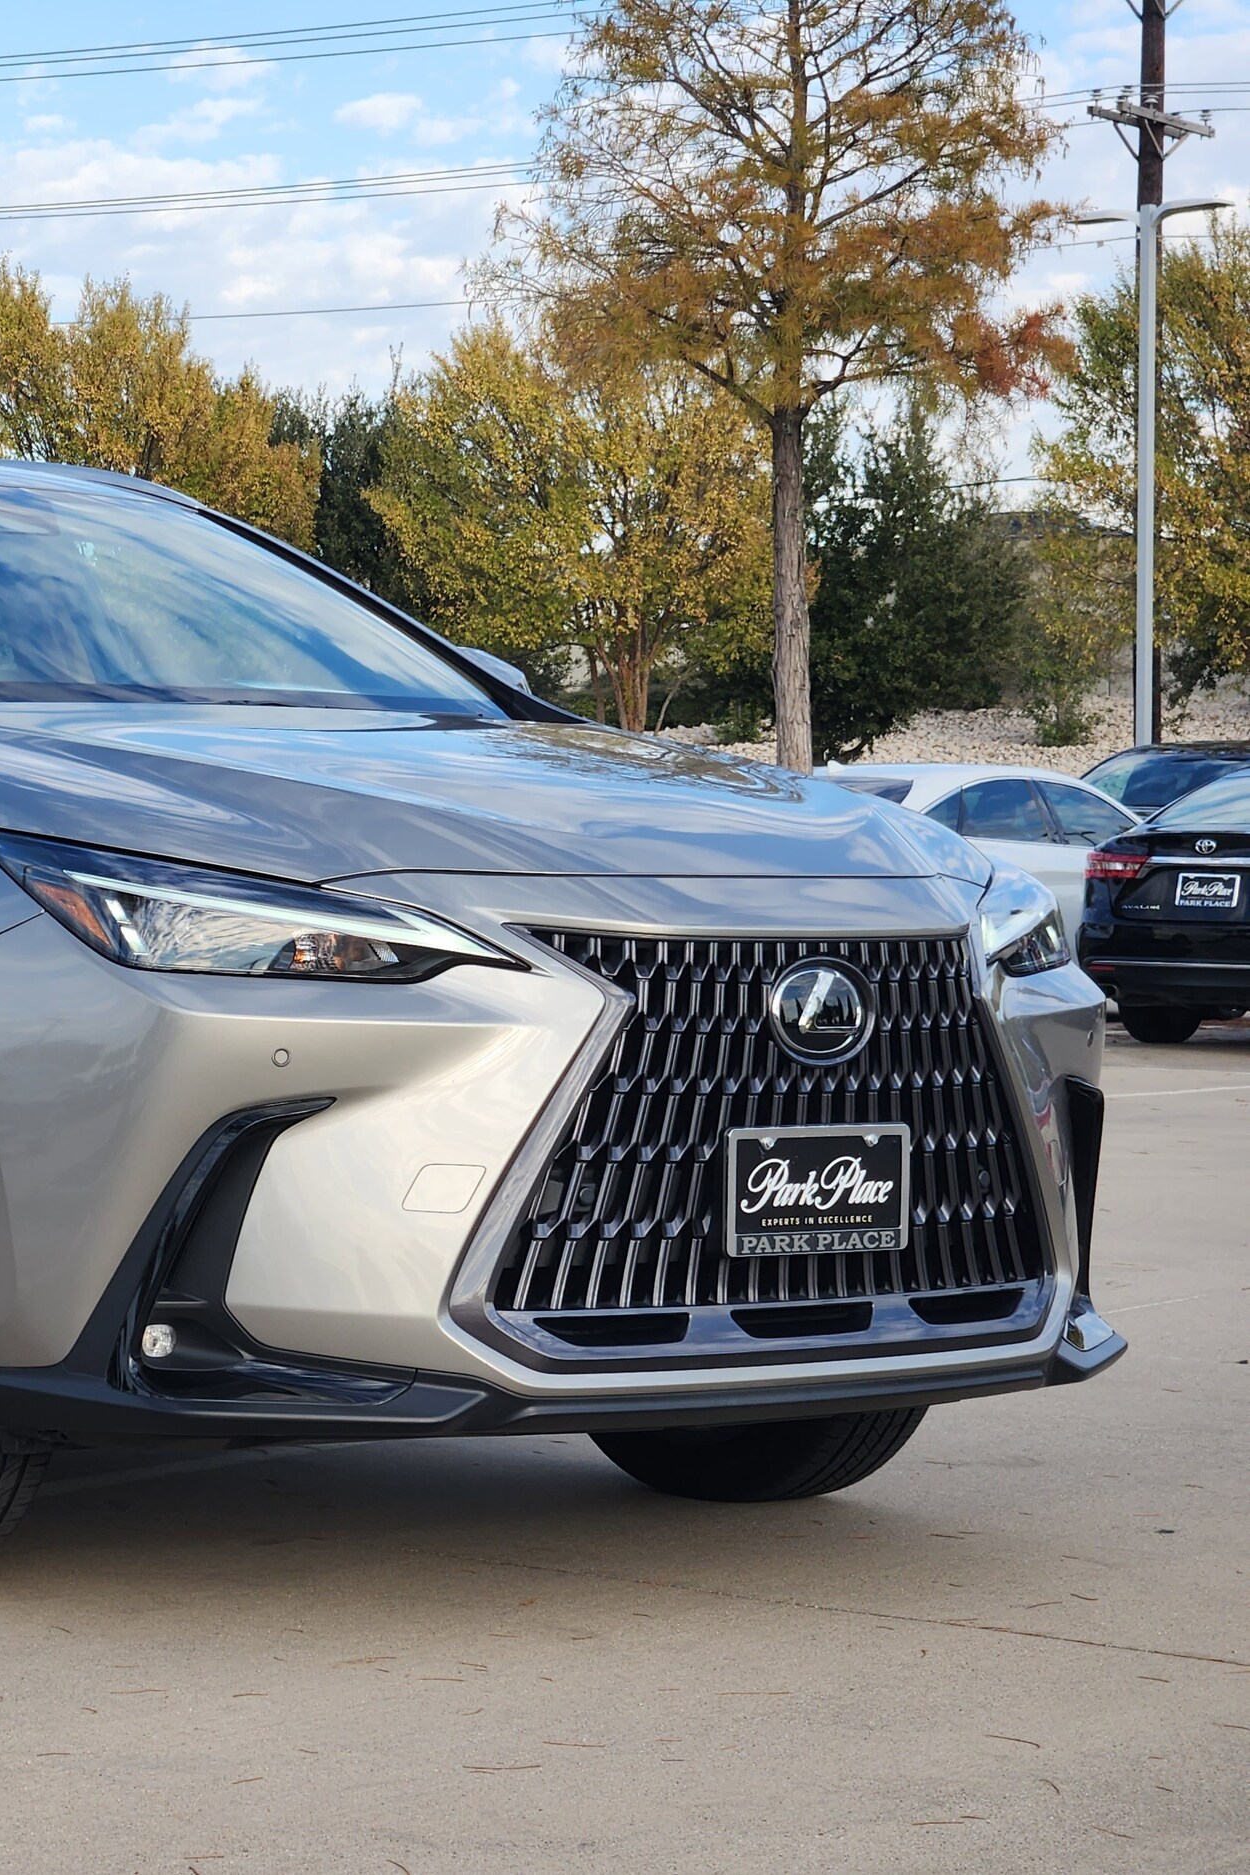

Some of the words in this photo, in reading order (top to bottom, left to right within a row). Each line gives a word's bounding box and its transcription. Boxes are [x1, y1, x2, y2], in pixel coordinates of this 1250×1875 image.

[1181, 881, 1208, 896] Park
[740, 1158, 819, 1214] Park
[814, 1156, 894, 1210] Place
[761, 1217, 800, 1227] EXPERTS
[804, 1216, 814, 1225] IN
[818, 1215, 873, 1224] EXCELLENCE
[741, 1234, 811, 1254] PARK
[816, 1231, 896, 1251] PLACE
